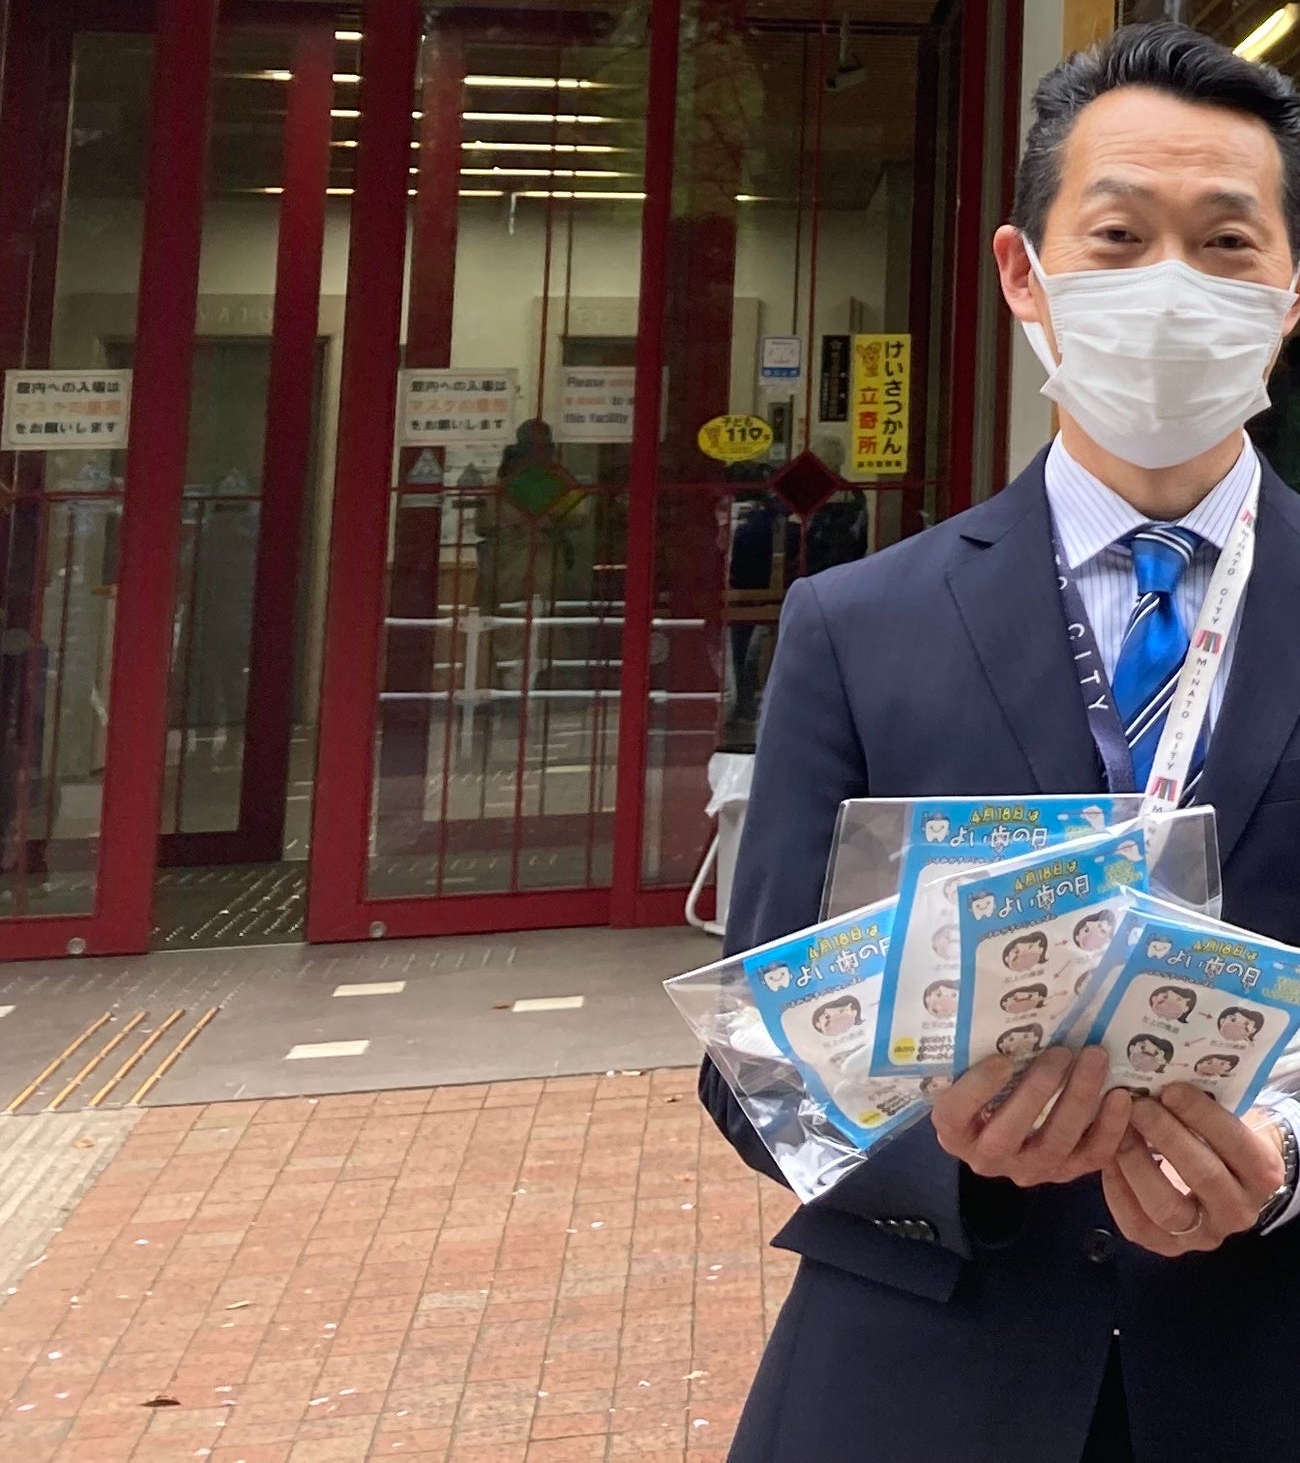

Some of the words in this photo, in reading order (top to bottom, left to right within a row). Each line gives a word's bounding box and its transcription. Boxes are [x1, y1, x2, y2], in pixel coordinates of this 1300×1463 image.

[567, 376, 606, 388] Please
[883, 341, 904, 455] けいさつかん
[858, 386, 878, 455] 立寄所
[1068, 623, 1109, 709] CITY
[1181, 658, 1207, 719] MINATO
[1166, 731, 1184, 770] CITY
[970, 804, 1041, 825] 4月18日は
[949, 824, 1048, 850] よい歯の日
[998, 873, 1091, 920] よい歯の日
[1014, 860, 1079, 892] 4月18日は
[1167, 949, 1262, 990] よい歯の日
